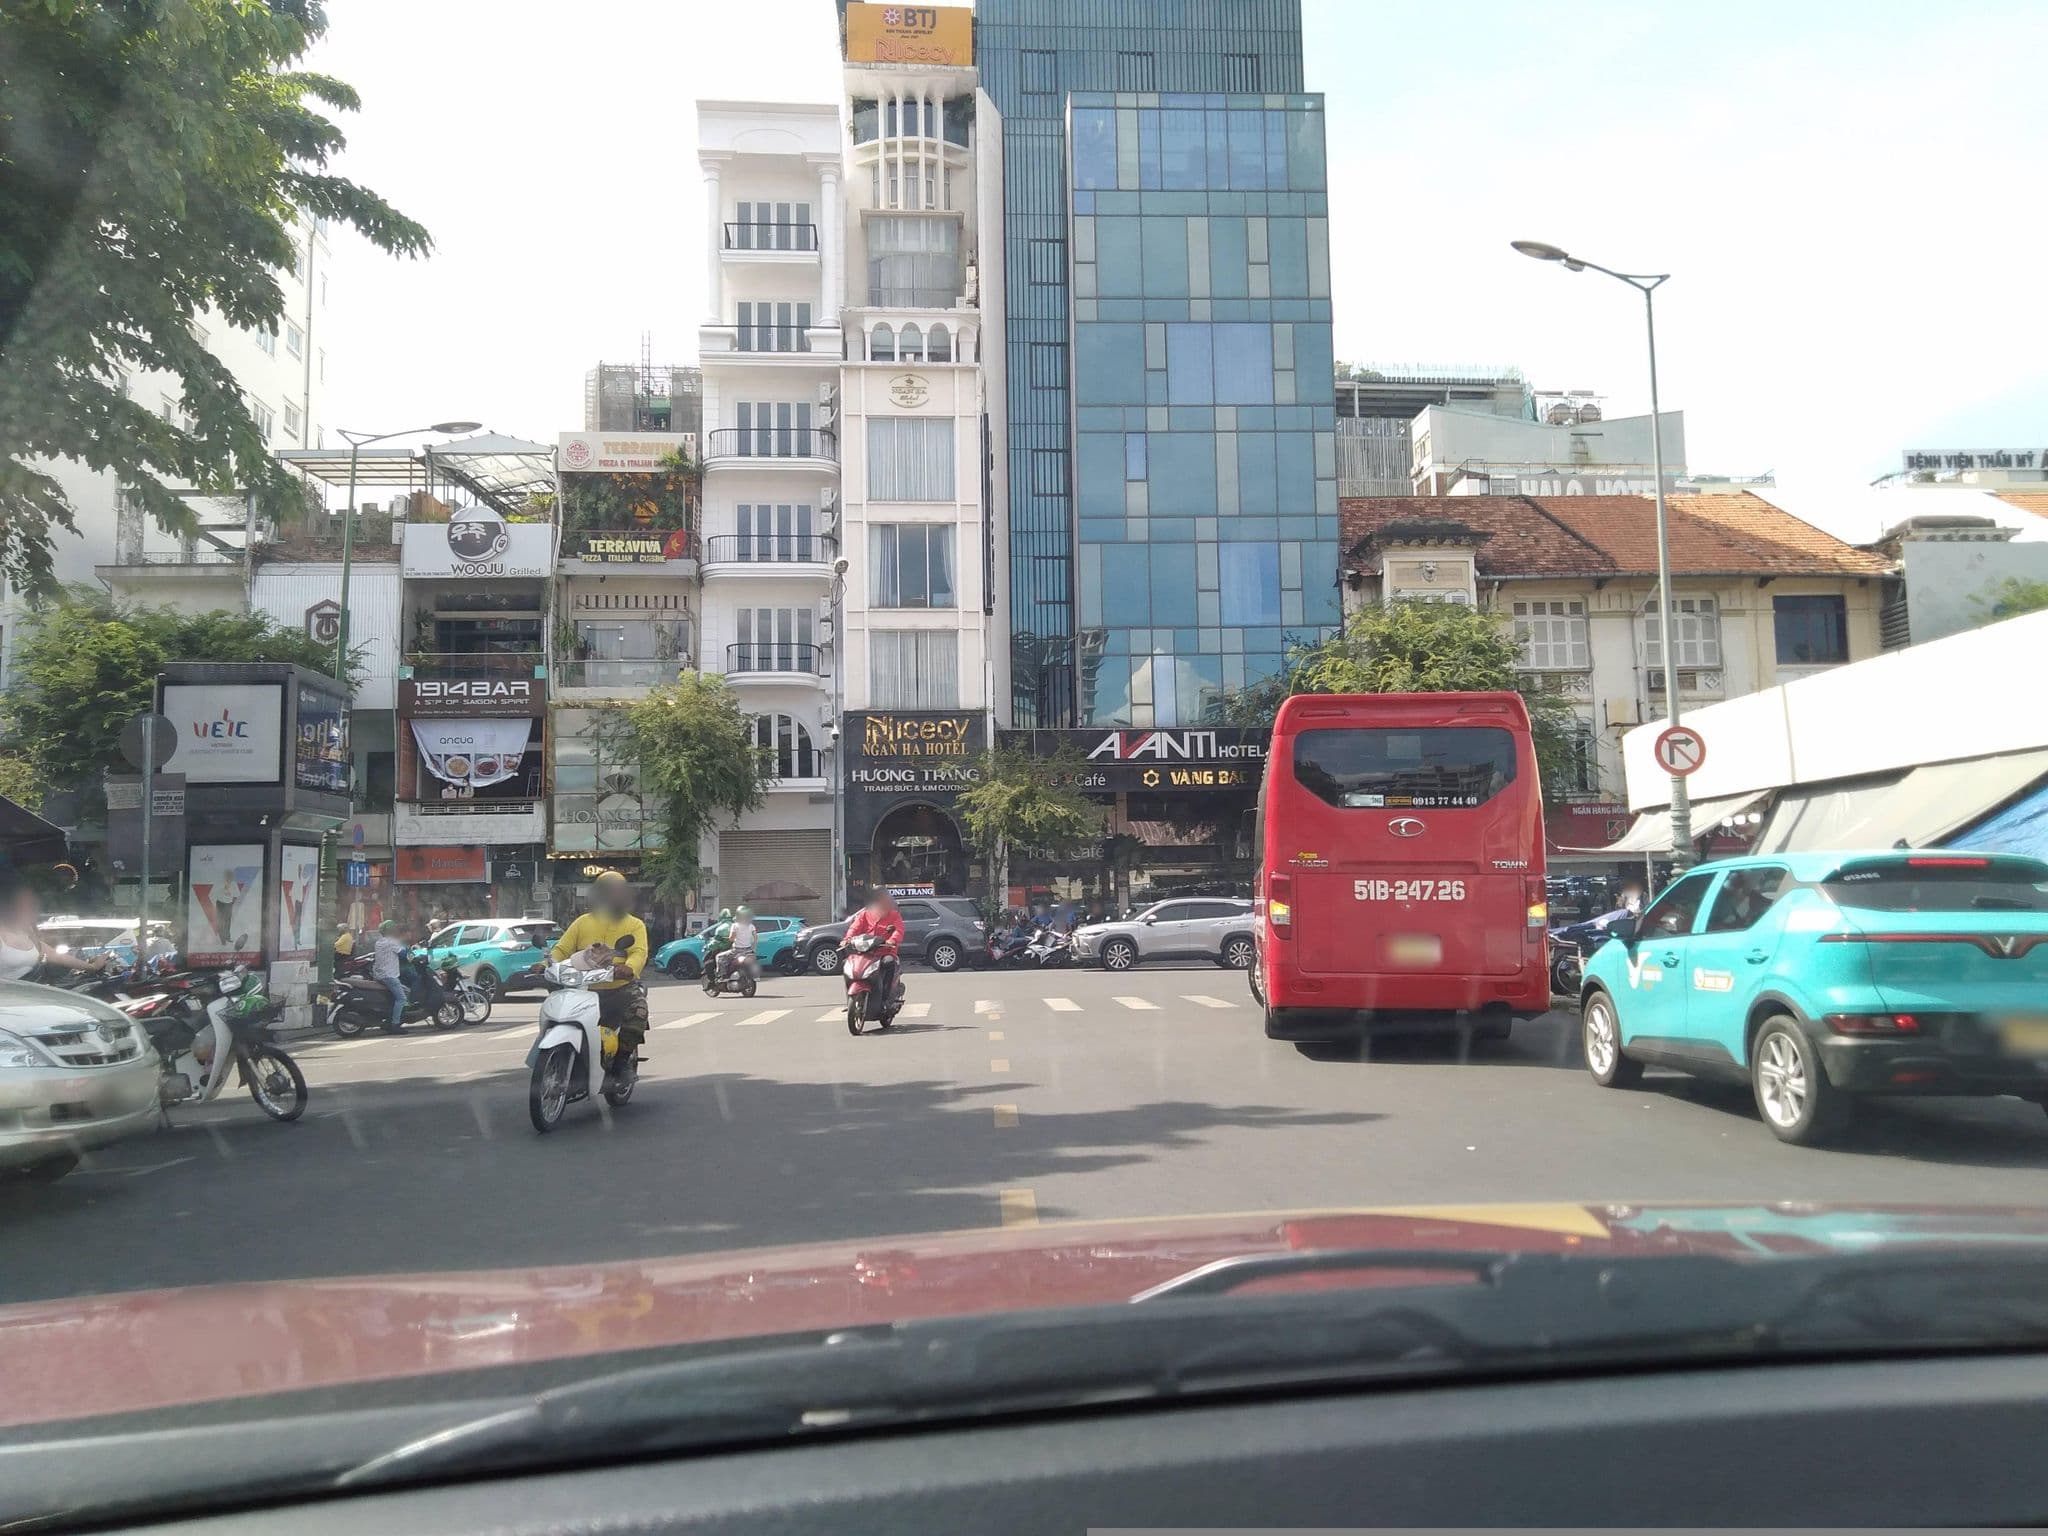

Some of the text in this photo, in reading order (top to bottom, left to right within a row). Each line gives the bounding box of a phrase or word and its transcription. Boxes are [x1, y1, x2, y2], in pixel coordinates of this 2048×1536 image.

[904, 8, 937, 28] BTJ
[599, 460, 618, 468] PIZZA
[628, 460, 652, 468] ITALIAN
[1596, 480, 1656, 496] HOTE
[589, 540, 662, 553] TERRAVIVA
[582, 554, 602, 562] PIZZA
[608, 554, 633, 562] ITALIAN
[451, 563, 504, 575] WOOJU
[510, 567, 541, 575] Grilled
[865, 716, 970, 744] Nicecy
[903, 743, 920, 755] HA
[926, 743, 969, 755] HOTEL
[1086, 732, 1265, 760] AVANTI HOTEL
[852, 768, 980, 782] HƯƠNG TRANG
[1075, 773, 1106, 787] Café
[1170, 768, 1214, 785] VÀNG
[1413, 797, 1435, 805] 0913
[1438, 797, 1448, 805] 77
[1451, 797, 1462, 805] 44
[1492, 860, 1528, 869] TOWN
[1354, 880, 1465, 900] 51B-247.26
